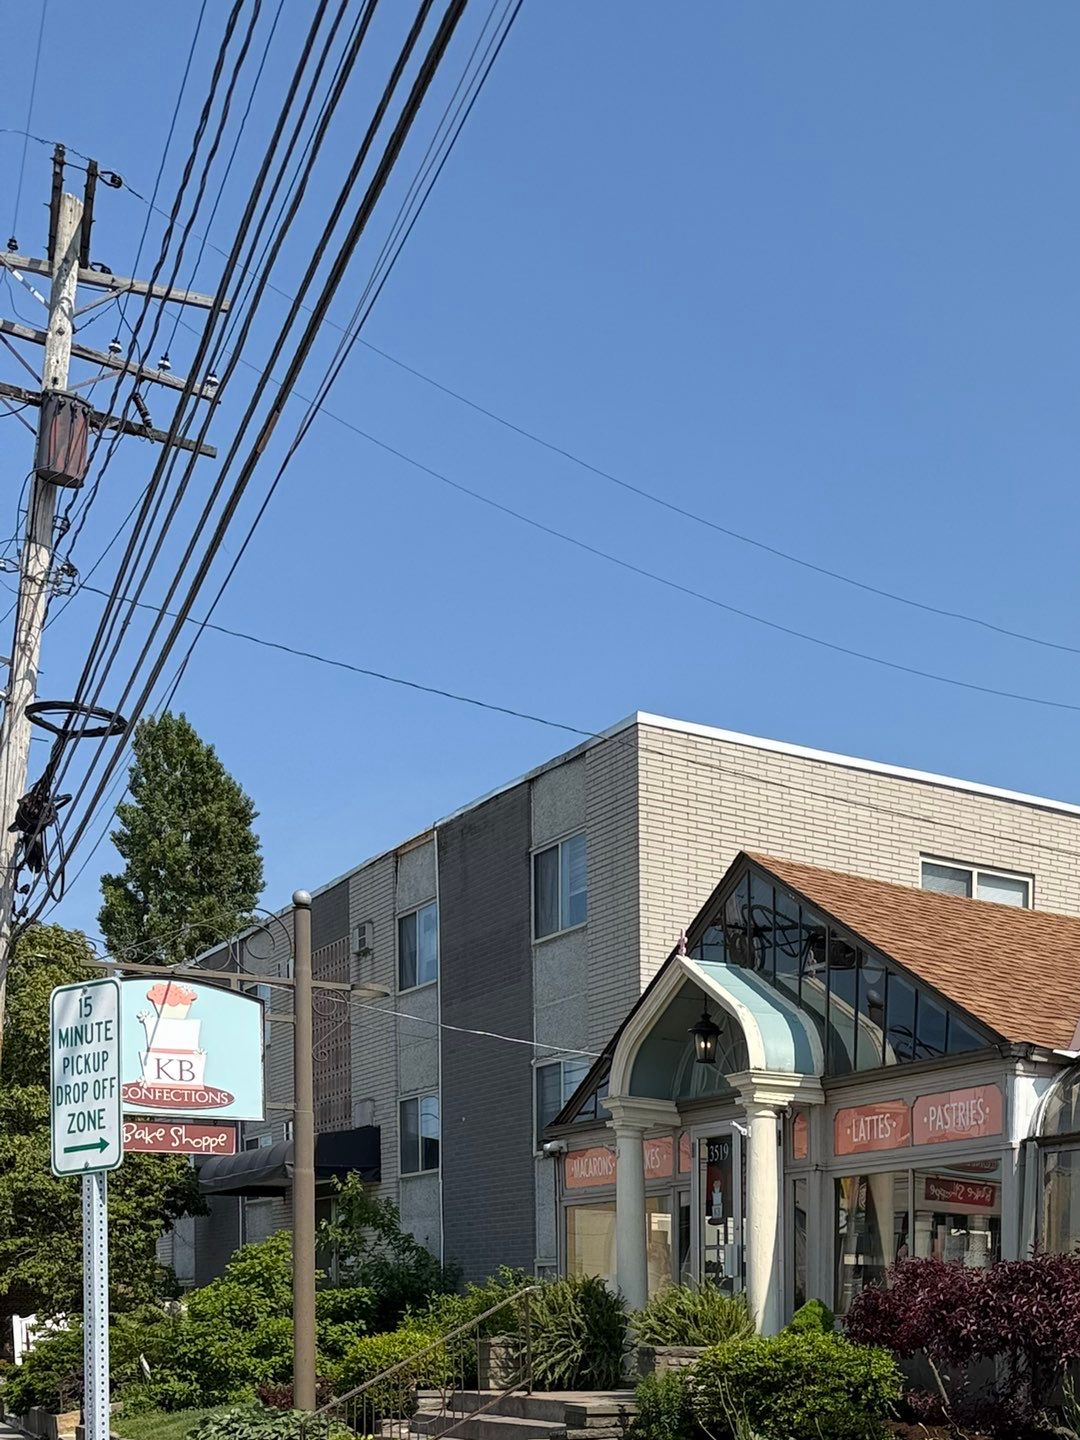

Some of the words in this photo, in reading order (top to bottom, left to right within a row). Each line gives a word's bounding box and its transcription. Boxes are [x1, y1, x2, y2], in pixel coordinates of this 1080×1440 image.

[78, 995, 93, 1019] 15
[58, 1019, 114, 1049] MINUTE
[62, 1050, 109, 1076] PICKUP
[155, 1057, 196, 1082] KB
[56, 1081, 91, 1107] DROP
[93, 1076, 117, 1101] OFF
[67, 1107, 106, 1135] ZONE
[852, 1113, 891, 1143] LATTES
[929, 1098, 985, 1132] PASTRIES
[122, 1122, 165, 1145] Bake
[170, 1125, 228, 1152] Shoppe
[644, 1148, 661, 1170] KES
[709, 1142, 729, 1162] 3519
[573, 1156, 613, 1179] MACARONS
